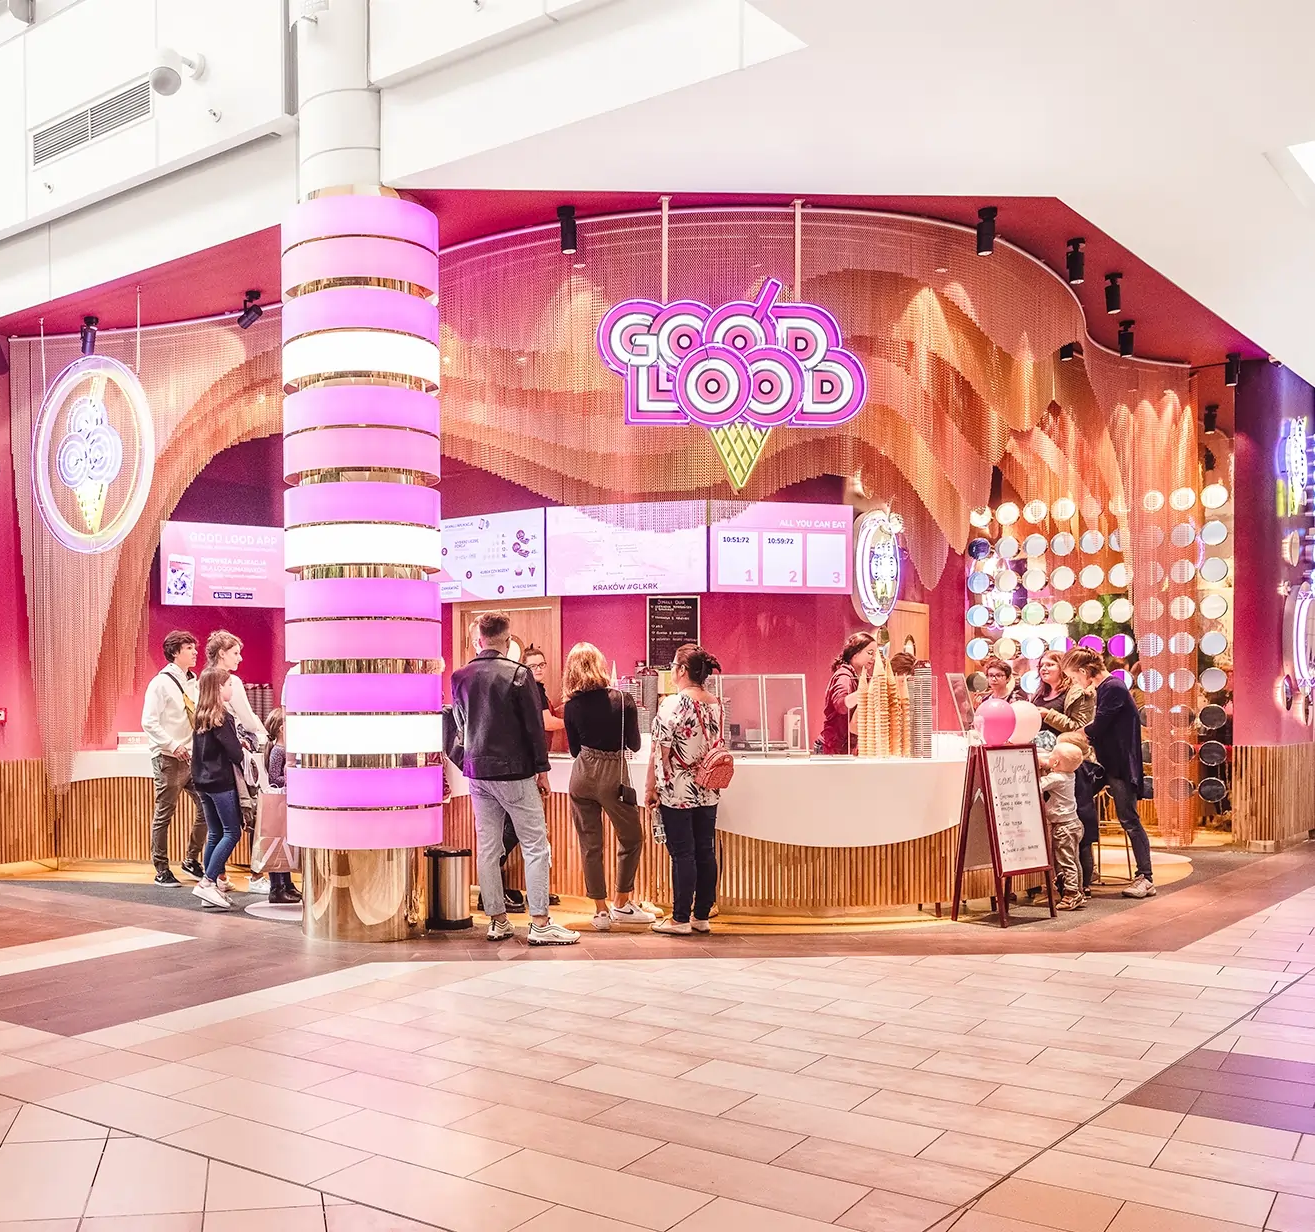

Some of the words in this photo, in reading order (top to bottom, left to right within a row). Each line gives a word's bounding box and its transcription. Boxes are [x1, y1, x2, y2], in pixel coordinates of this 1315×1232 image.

[597, 299, 843, 374] GOOD
[625, 344, 867, 427] LOOD
[779, 519, 794, 527] ALL
[796, 519, 812, 528] YOU
[813, 520, 830, 528] CAN
[189, 531, 223, 543] GOOD
[224, 533, 255, 545] LOOD
[256, 536, 278, 546] APP
[722, 536, 750, 544] 10:51:72
[745, 569, 754, 582] 1
[789, 570, 798, 583] 2
[832, 571, 841, 584] 3
[592, 581, 626, 591] KRAKÓW
[990, 755, 1008, 773] All
[1011, 763, 1027, 783] you
[997, 776, 1013, 786] can
[1018, 769, 1033, 784] eat
